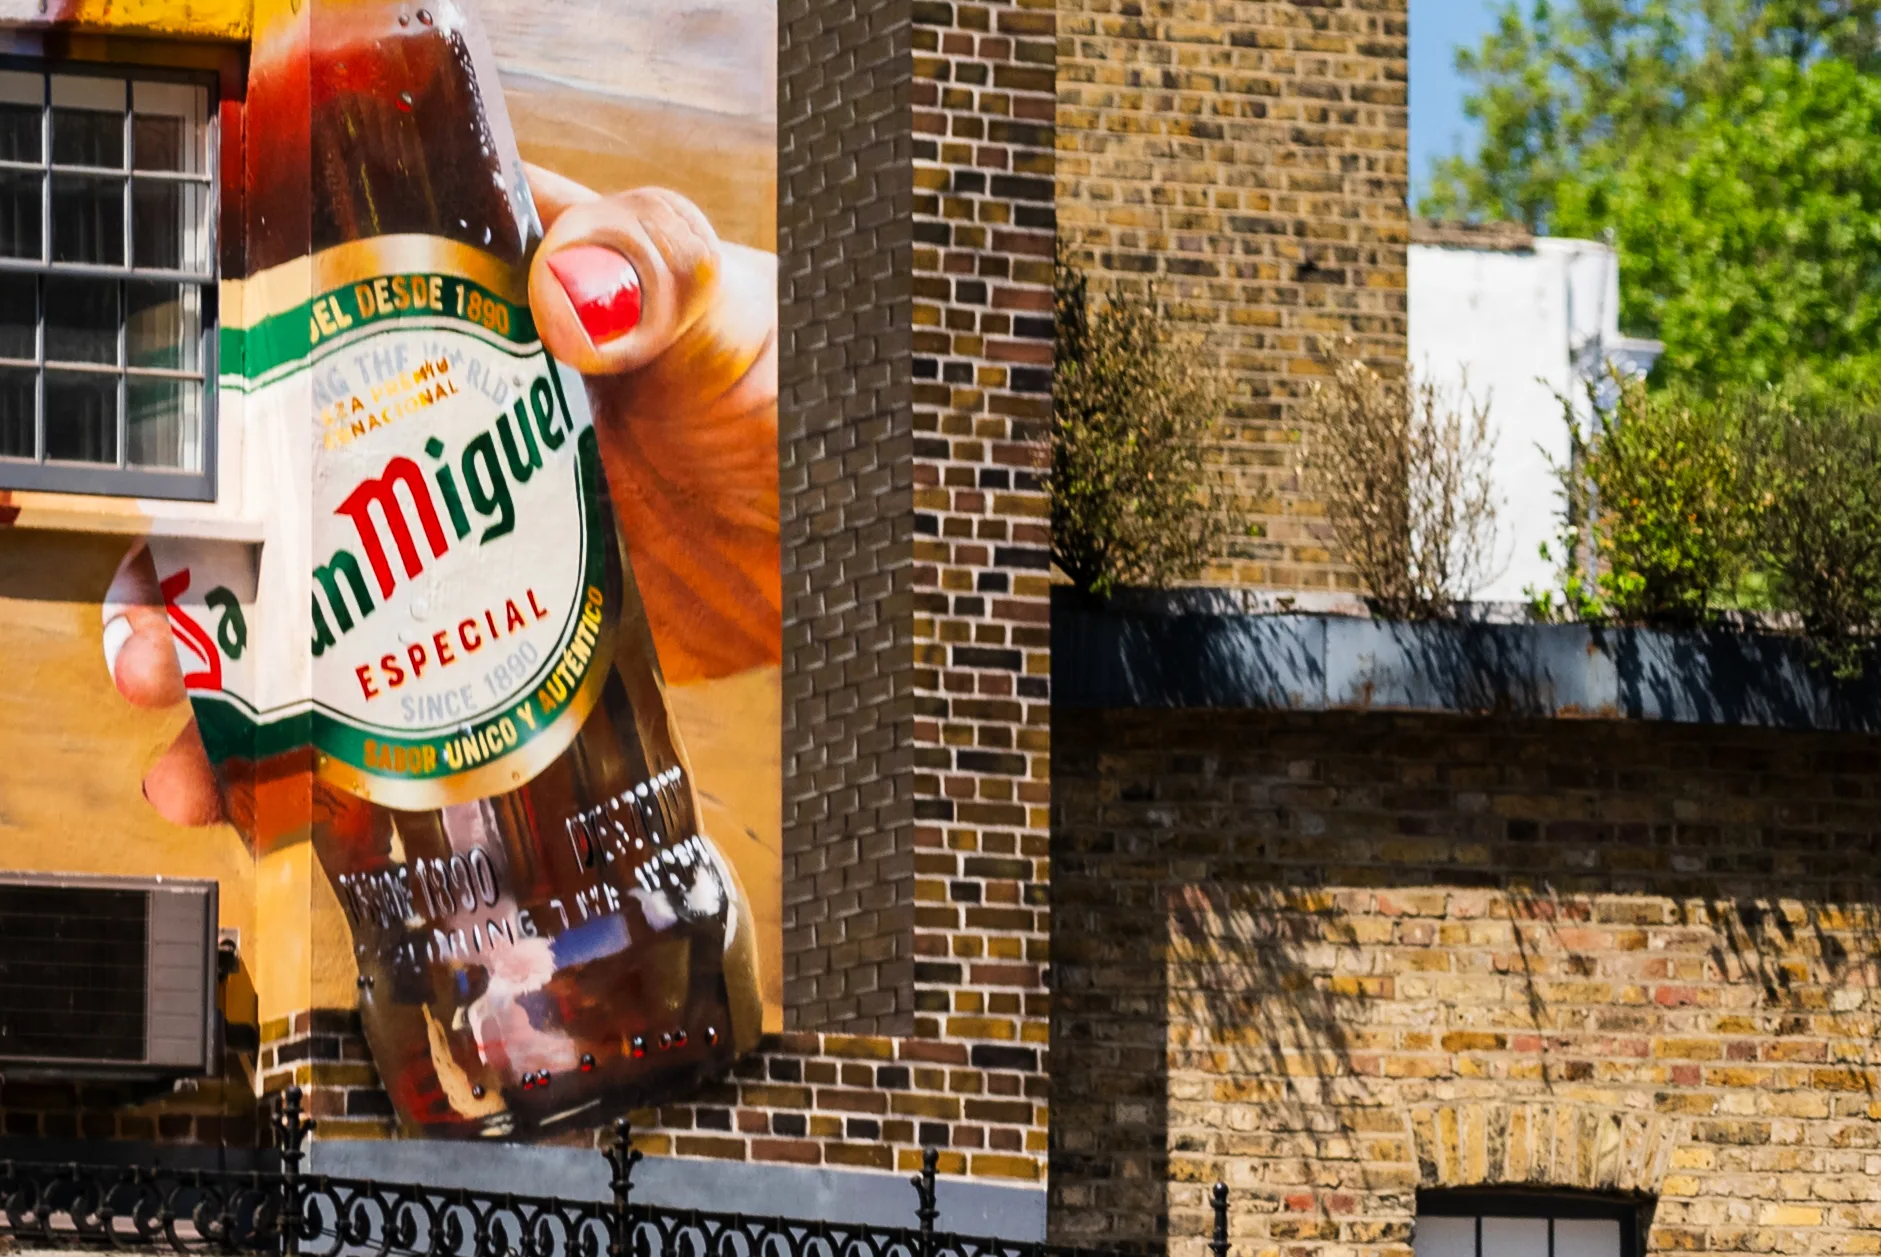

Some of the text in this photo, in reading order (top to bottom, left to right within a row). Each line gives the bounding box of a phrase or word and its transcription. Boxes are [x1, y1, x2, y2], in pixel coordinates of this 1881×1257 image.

[354, 275, 444, 318] DESDE
[455, 283, 510, 336] 1890
[354, 341, 408, 385] THE
[355, 588, 549, 702] ESPECIAL
[400, 640, 539, 723] SINCE 1890
[363, 739, 437, 773] SABOR
[516, 701, 536, 731] Y
